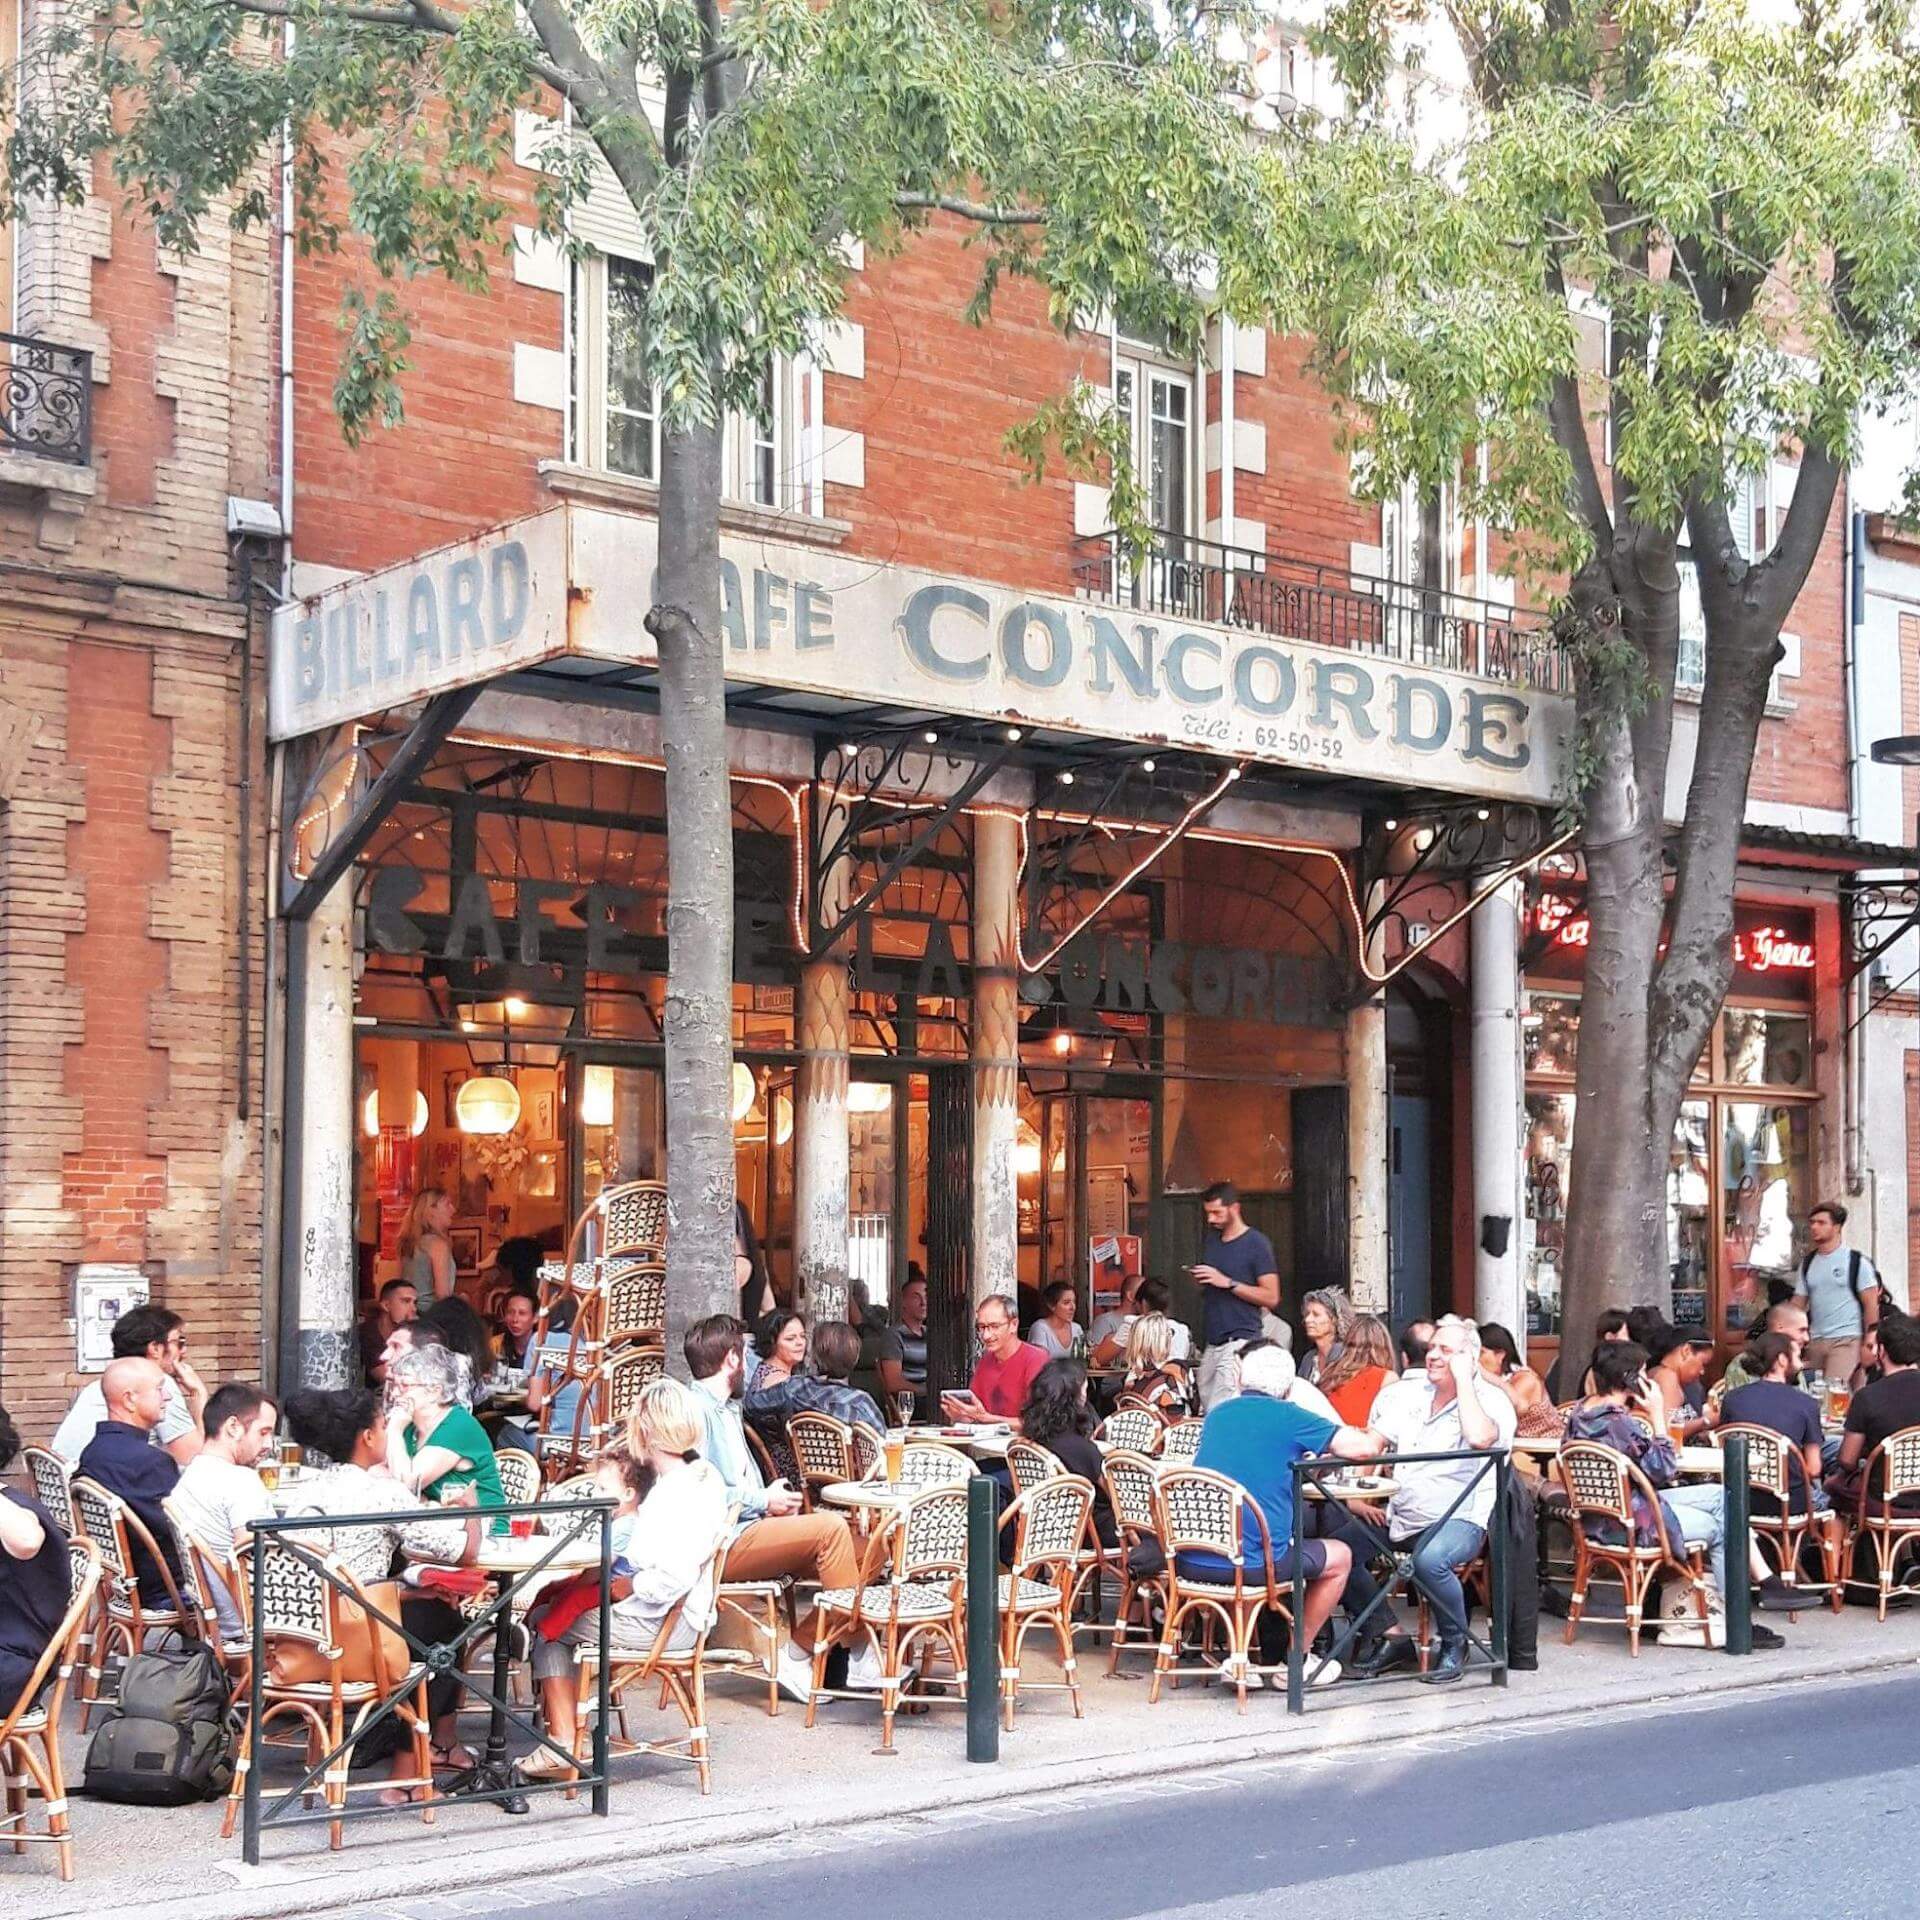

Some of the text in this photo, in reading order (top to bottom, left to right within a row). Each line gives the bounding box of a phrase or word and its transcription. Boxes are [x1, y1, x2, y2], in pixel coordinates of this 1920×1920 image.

[294, 541, 529, 706] BILLARD
[650, 558, 1531, 770] AFÉ CONCORDE
[857, 913, 963, 995] LA
